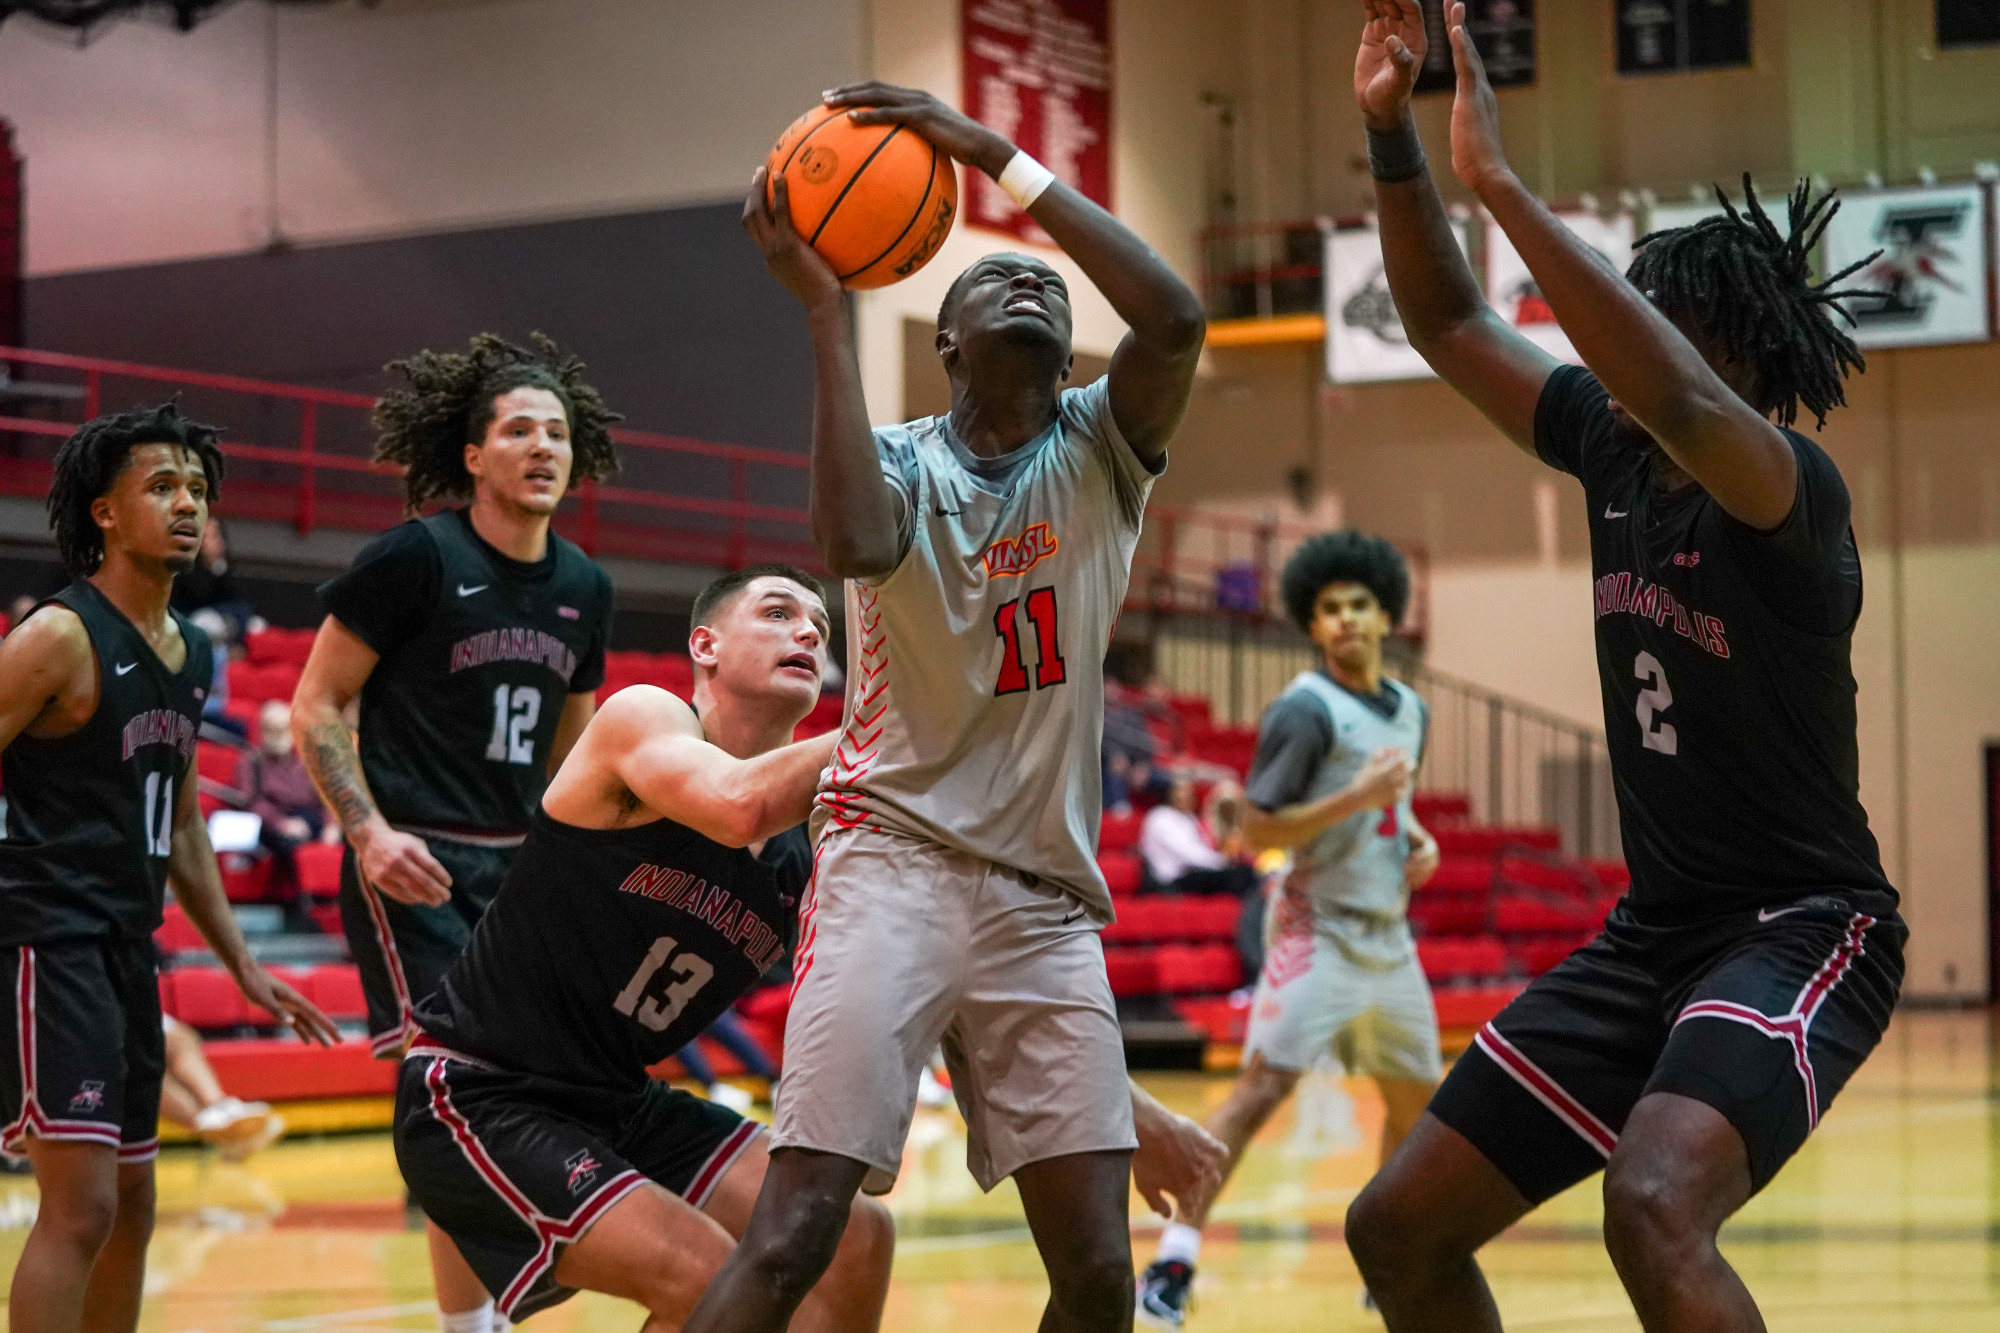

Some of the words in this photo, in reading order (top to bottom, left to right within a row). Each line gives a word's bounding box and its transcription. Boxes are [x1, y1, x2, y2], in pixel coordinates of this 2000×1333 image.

[993, 585, 1067, 697] 11
[485, 683, 543, 764] 12
[1634, 650, 1678, 756] 2
[144, 770, 174, 857] 11
[612, 936, 715, 1033] 13
